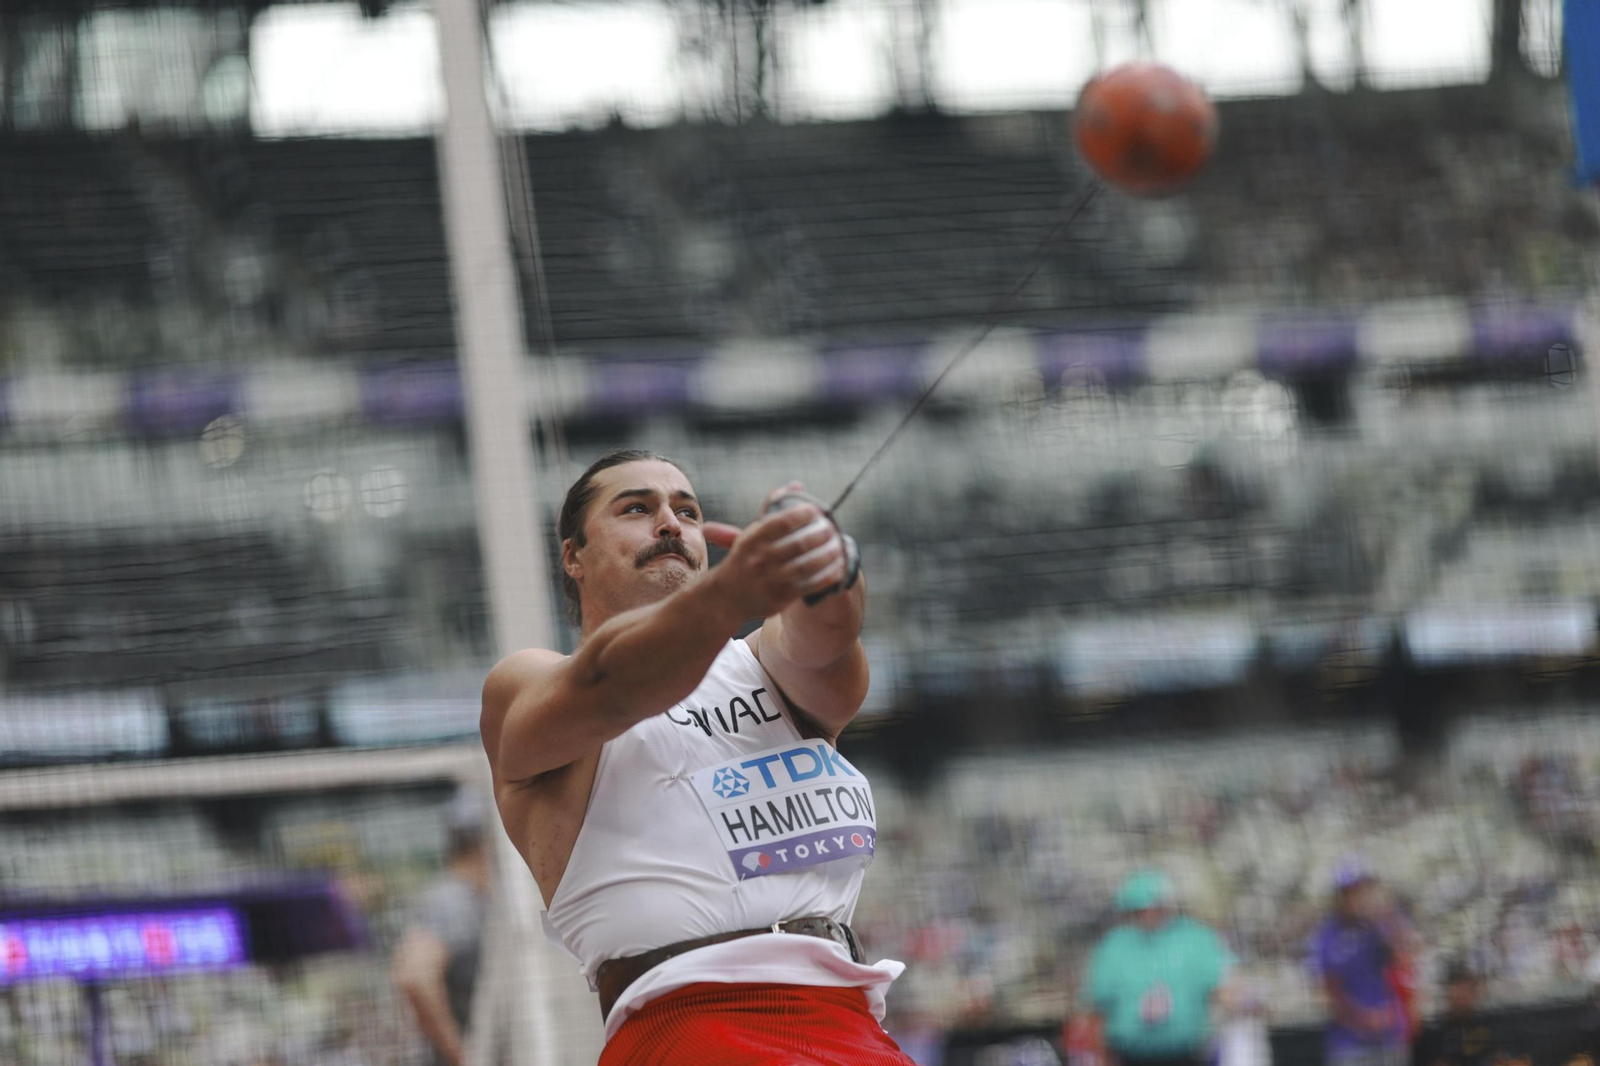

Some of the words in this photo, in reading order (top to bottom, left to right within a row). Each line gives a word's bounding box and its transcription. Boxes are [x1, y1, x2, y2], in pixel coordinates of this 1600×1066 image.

[740, 744, 857, 789] TDK
[720, 786, 874, 844] HAMILTON
[866, 834, 876, 849] 2
